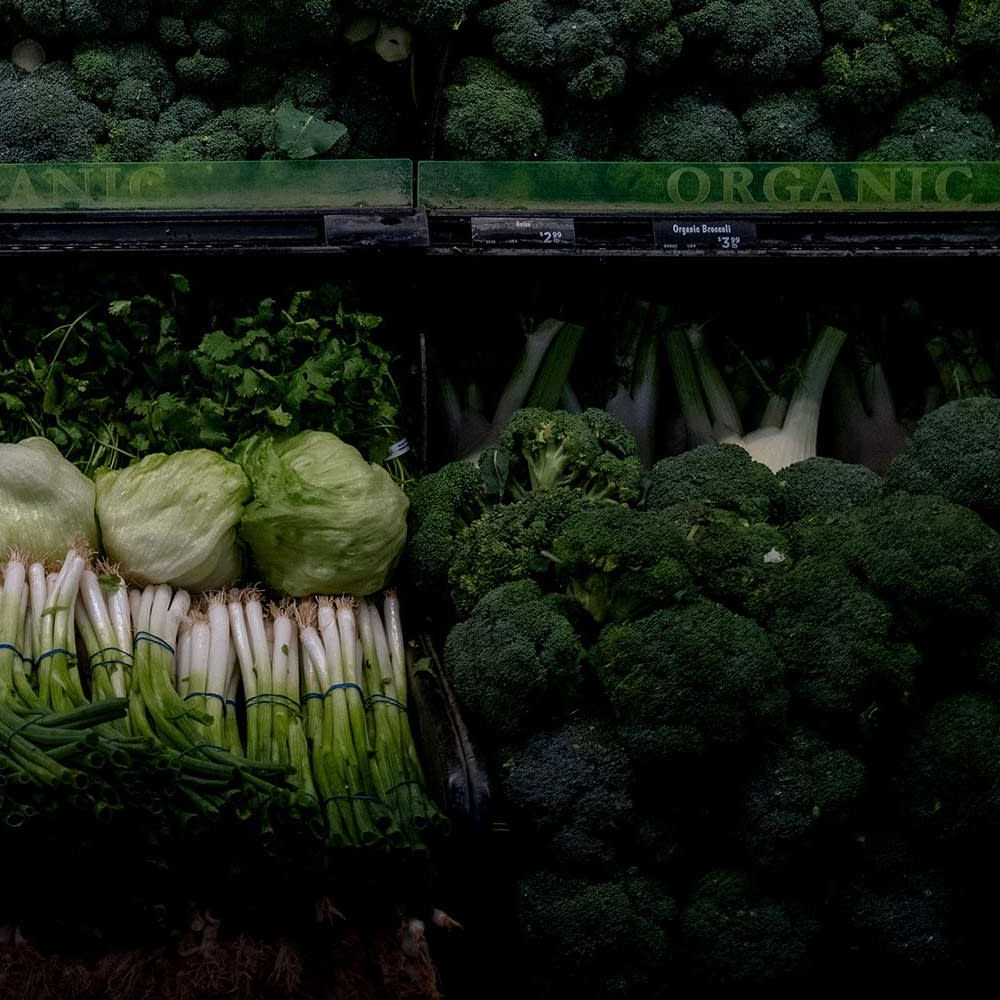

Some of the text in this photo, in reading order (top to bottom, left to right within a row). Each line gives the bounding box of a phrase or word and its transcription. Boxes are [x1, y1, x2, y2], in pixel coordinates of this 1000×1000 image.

[667, 166, 974, 203] ORGANIC
[673, 224, 731, 236] Organic Broccoli
